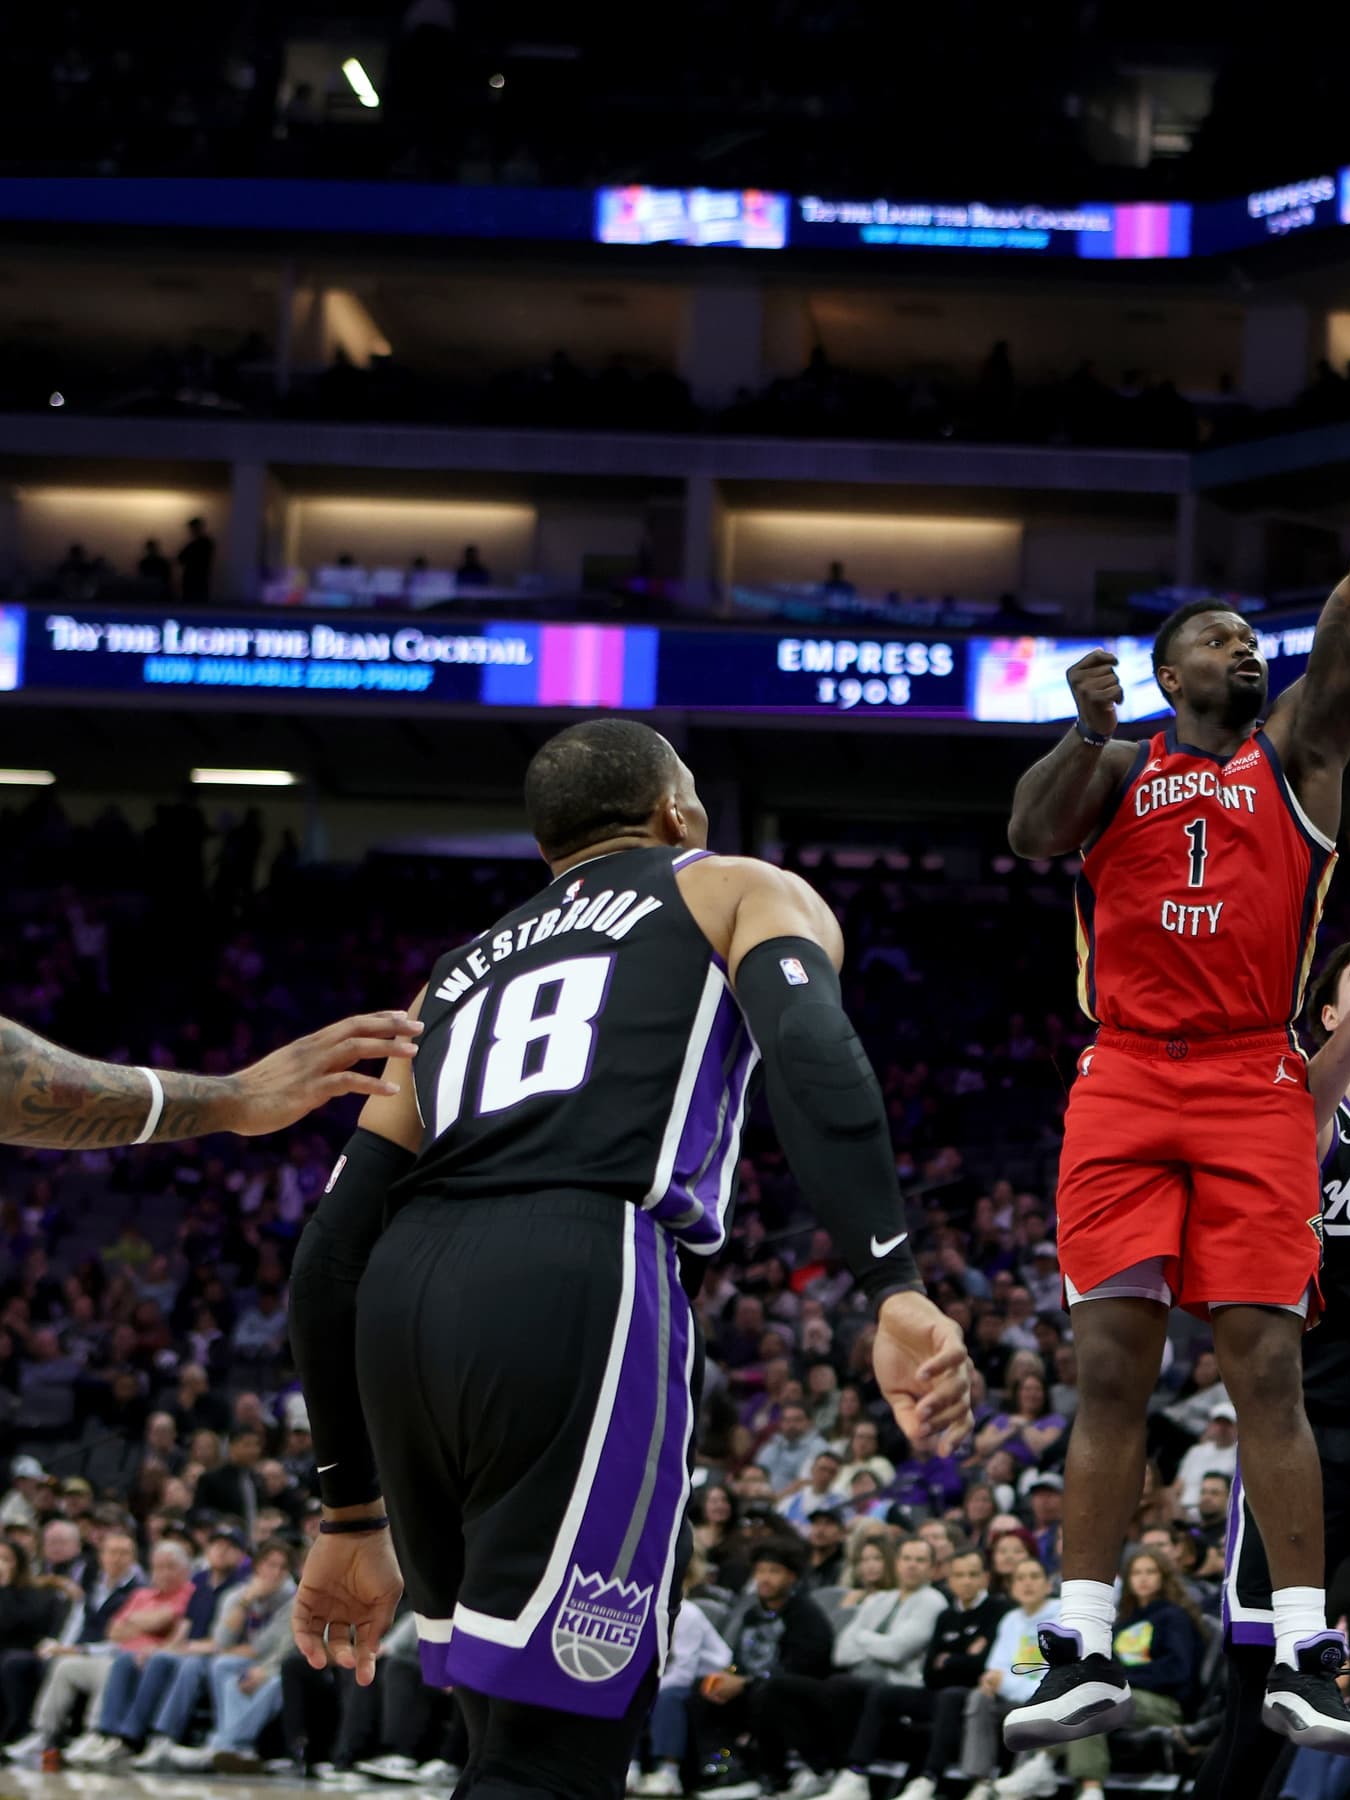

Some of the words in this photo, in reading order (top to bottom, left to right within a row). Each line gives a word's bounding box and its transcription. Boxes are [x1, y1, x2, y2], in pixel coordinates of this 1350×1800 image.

[777, 638, 954, 676] EMPRESS
[818, 674, 911, 710] 1908
[1184, 818, 1207, 888] 1
[1161, 900, 1224, 936] CITY
[435, 890, 663, 1003] WESTBROOK
[433, 953, 617, 1140] 18
[558, 1610, 639, 1648] KINGS
[570, 1600, 642, 1625] SACRAMENTO
